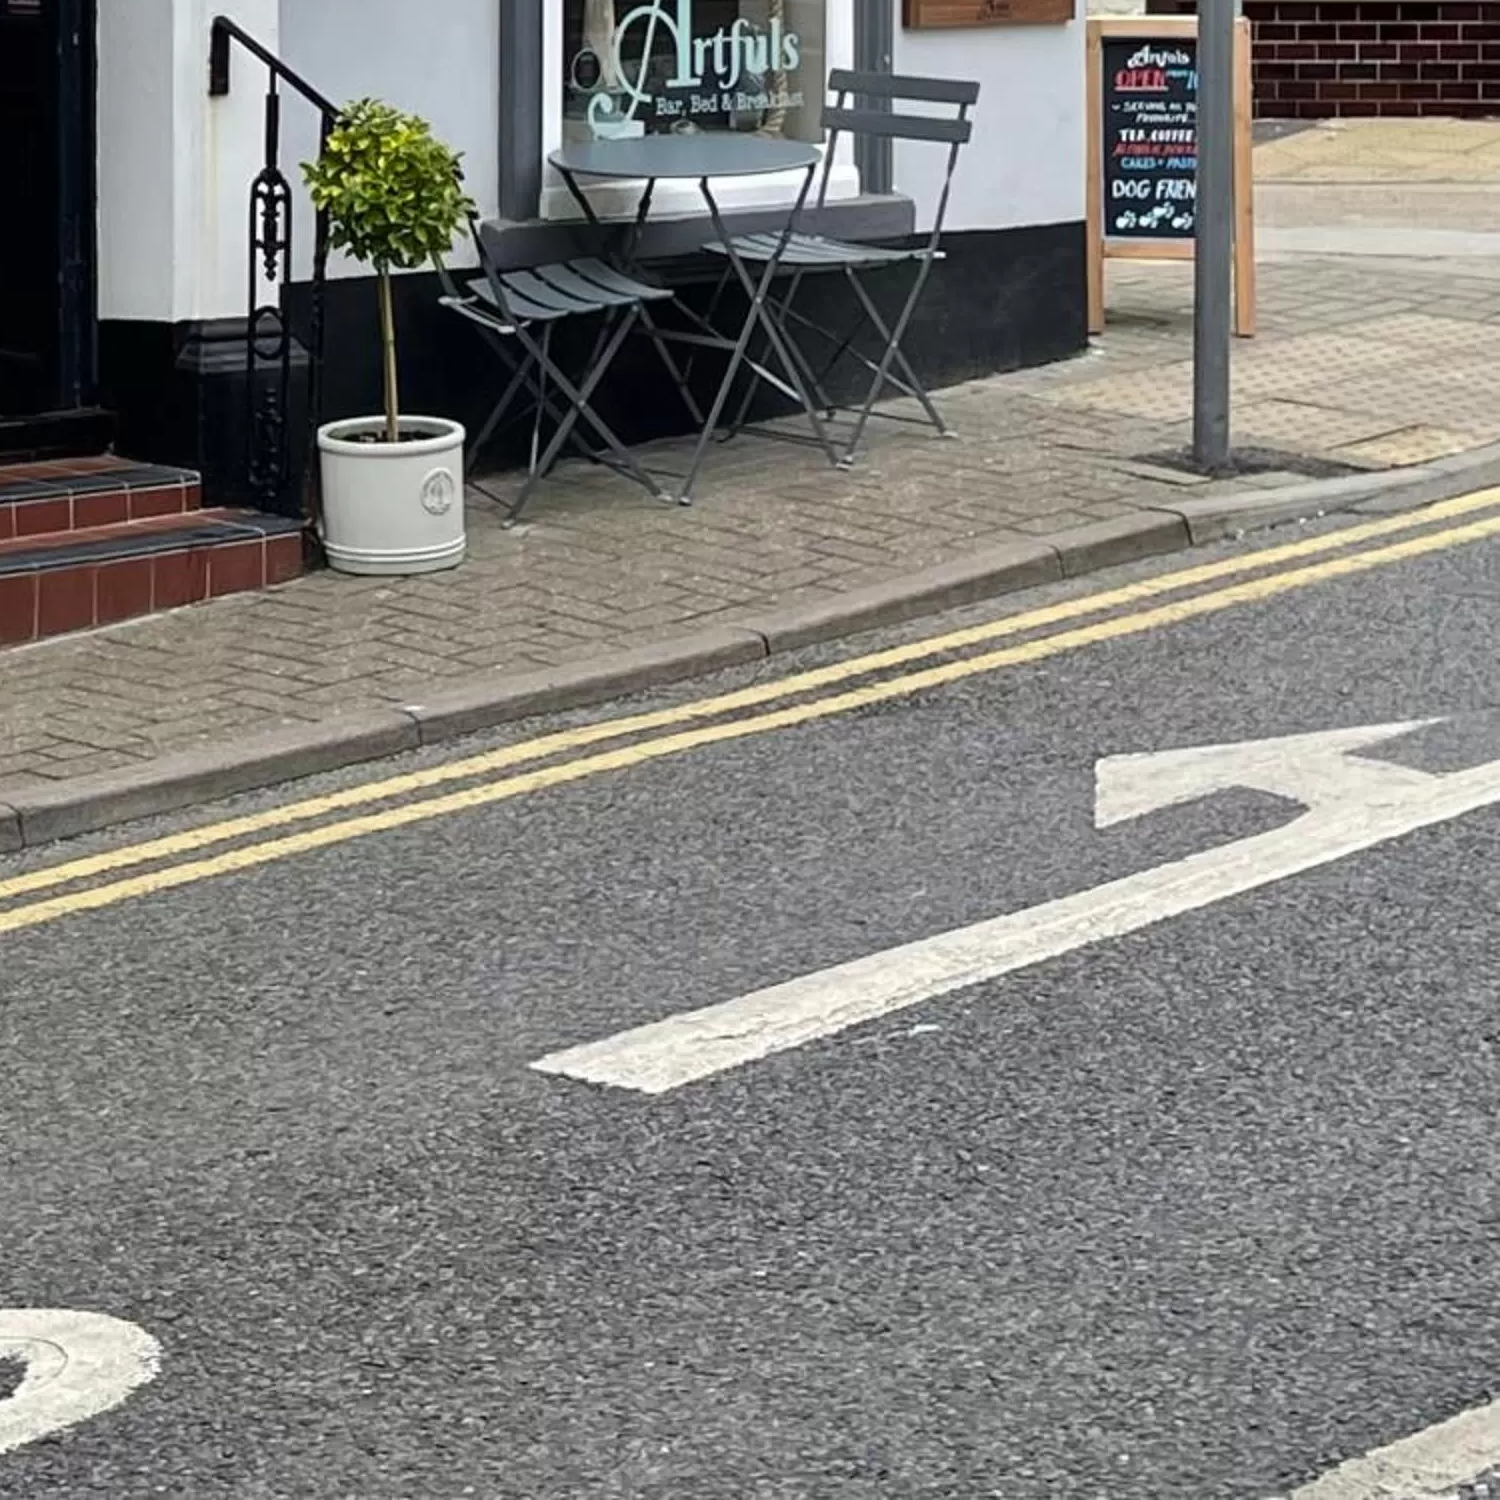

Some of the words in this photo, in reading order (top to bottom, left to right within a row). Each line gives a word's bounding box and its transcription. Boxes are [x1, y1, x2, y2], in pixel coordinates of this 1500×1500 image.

[1115, 69, 1165, 87] OPEN
[690, 93, 717, 113] Bed
[721, 92, 732, 111] &
[1112, 179, 1151, 199] DOG
[1155, 179, 1196, 200] FRIEN
